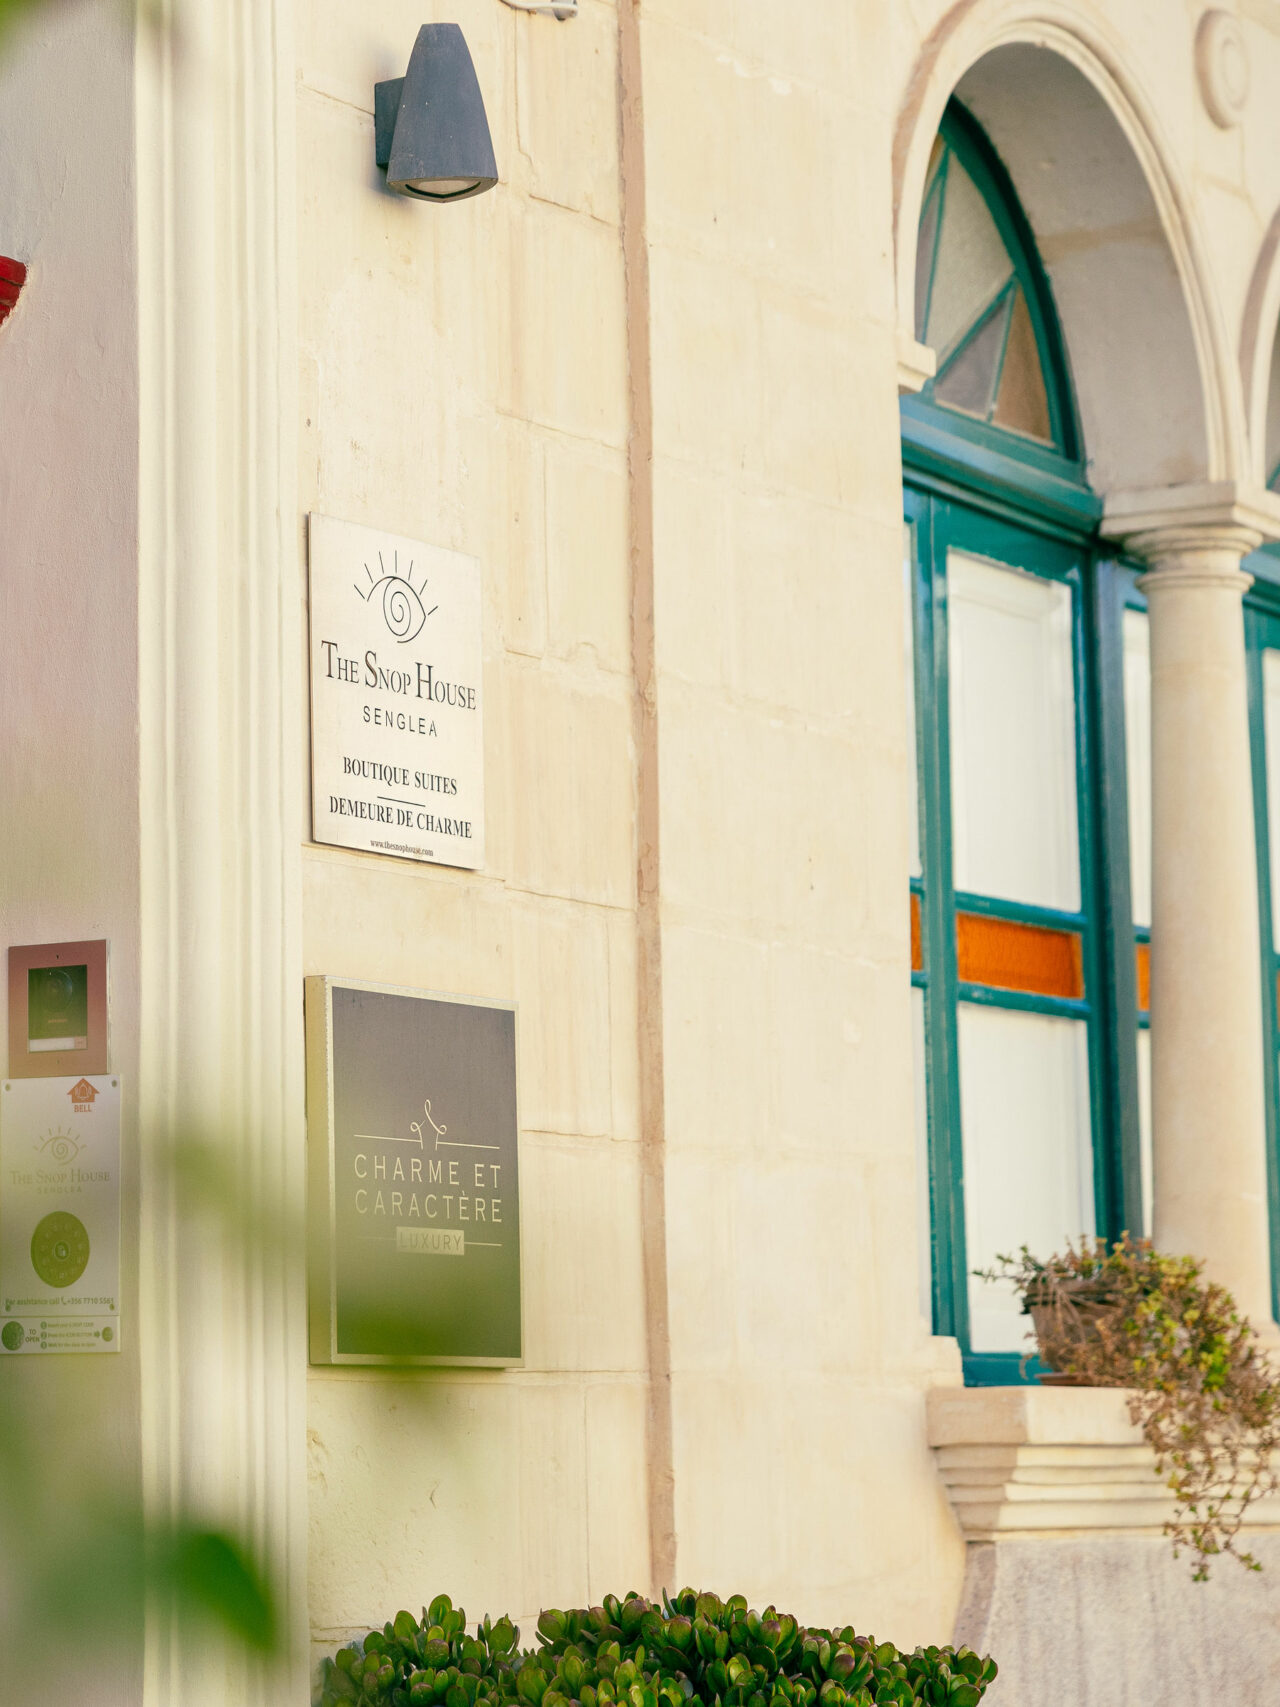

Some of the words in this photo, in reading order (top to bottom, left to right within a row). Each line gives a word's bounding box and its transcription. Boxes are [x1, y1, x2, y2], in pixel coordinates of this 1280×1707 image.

[321, 640, 360, 684] THE
[364, 650, 411, 695] SNOP
[415, 662, 477, 710] HOUSE
[363, 705, 438, 737] SENGLEA
[343, 756, 410, 787] BOUTIQUE
[414, 771, 458, 796] SUITES
[329, 796, 394, 825] DEMEURE
[396, 808, 414, 828] DE
[416, 812, 473, 839] CHARME
[74, 1103, 93, 1113] BELL
[354, 1153, 460, 1186] CHARME
[474, 1163, 501, 1188] ET
[355, 1189, 502, 1222] CARACTÈRE
[398, 1231, 462, 1251] LUXURY
[25, 1335, 40, 1343] OPEN
[28, 1328, 37, 1336] TO
